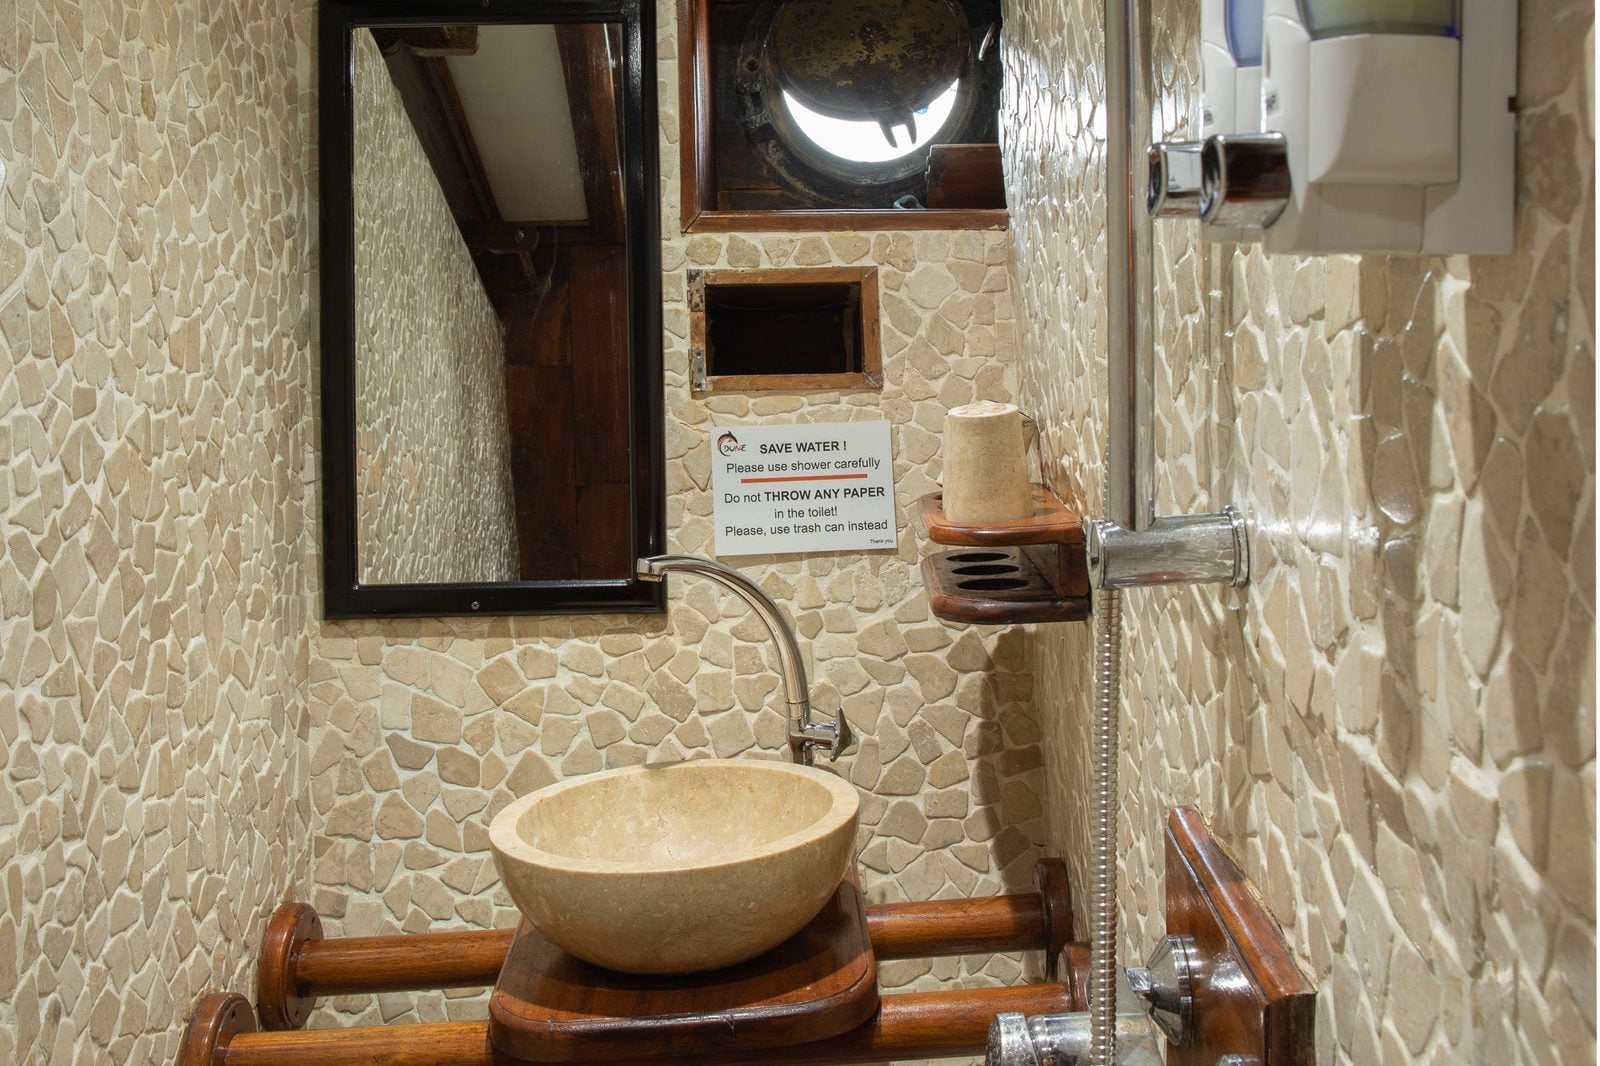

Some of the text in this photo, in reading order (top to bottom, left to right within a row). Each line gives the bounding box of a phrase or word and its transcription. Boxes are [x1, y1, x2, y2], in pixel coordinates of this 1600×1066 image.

[760, 441, 847, 454] SAVE WATER !
[726, 458, 880, 473] Please use shower carefully
[724, 487, 884, 503] Do not THROW ANY PAPER
[774, 506, 837, 519] in the toilet!
[725, 520, 887, 536] Please, use trash can instead
